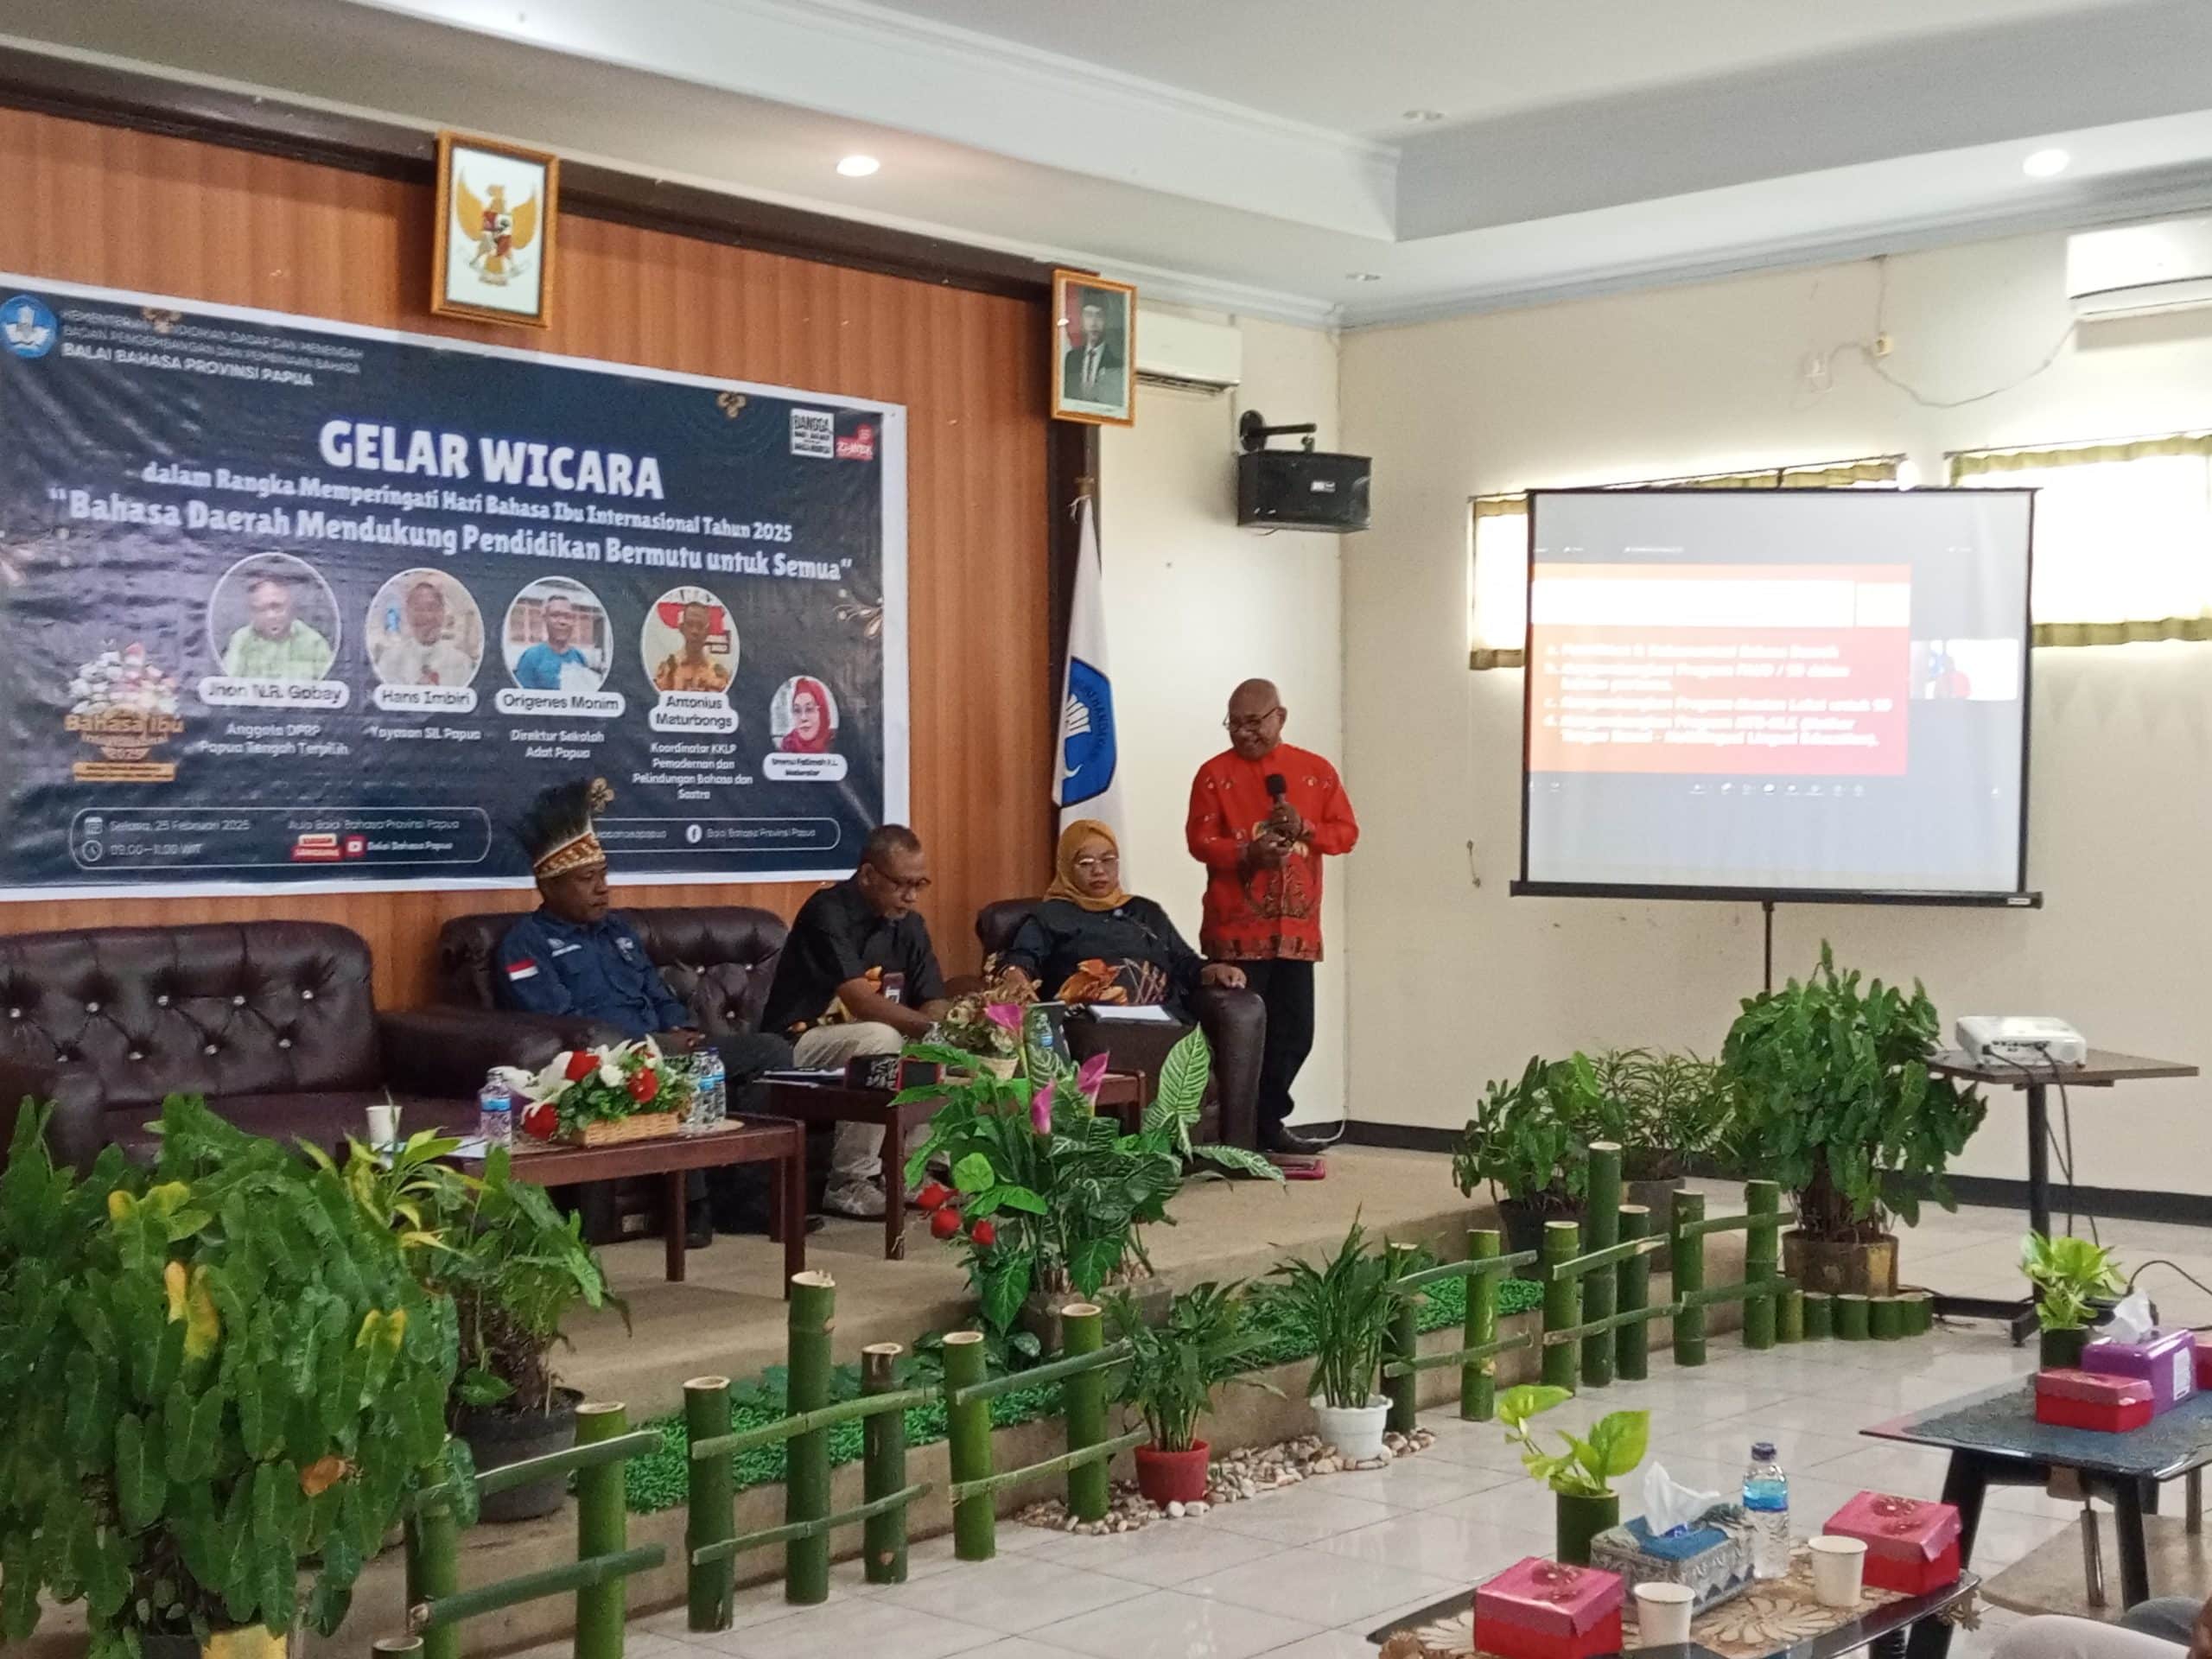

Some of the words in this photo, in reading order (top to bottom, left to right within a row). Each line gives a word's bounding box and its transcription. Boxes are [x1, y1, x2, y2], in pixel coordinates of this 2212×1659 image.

[61, 342, 111, 360] BALAI
[114, 349, 181, 369] BAHASA
[183, 358, 259, 379] PROVINSI
[261, 368, 314, 386] PAPUA
[320, 420, 469, 479] GELAR
[479, 437, 664, 499] WICARA
[141, 461, 212, 487] dalam
[216, 467, 296, 498] Rangka
[298, 476, 439, 512] Memperingati
[442, 490, 482, 513] Hari
[486, 494, 550, 519] Bahasa
[553, 501, 584, 522] Ibu
[586, 505, 701, 534] Internasional
[702, 516, 750, 538] Tahun
[752, 521, 793, 543] 2025
[187, 499, 290, 537] Daerah
[296, 509, 458, 556] Mendukung
[461, 524, 601, 561] Pendidikan
[606, 537, 702, 569] Bermutu
[706, 550, 770, 575] untuk
[289, 684, 342, 704] Gobay
[382, 690, 420, 703] Hans
[423, 690, 471, 705] Imbiri
[504, 694, 567, 710] Origenes
[571, 696, 619, 709] Monim
[666, 696, 722, 709] Antonius
[656, 713, 733, 729] Maturbongs
[226, 723, 284, 739] Anggota
[370, 726, 423, 741] Yayasan
[443, 728, 481, 741] Papua
[511, 729, 557, 742] Direktur
[559, 730, 605, 742] Sekolah
[199, 741, 243, 755] Papua
[525, 747, 553, 758] Adat
[554, 747, 590, 760] Papua
[651, 742, 709, 754] Koordinator
[716, 759, 735, 769] dan
[734, 774, 753, 785] dan
